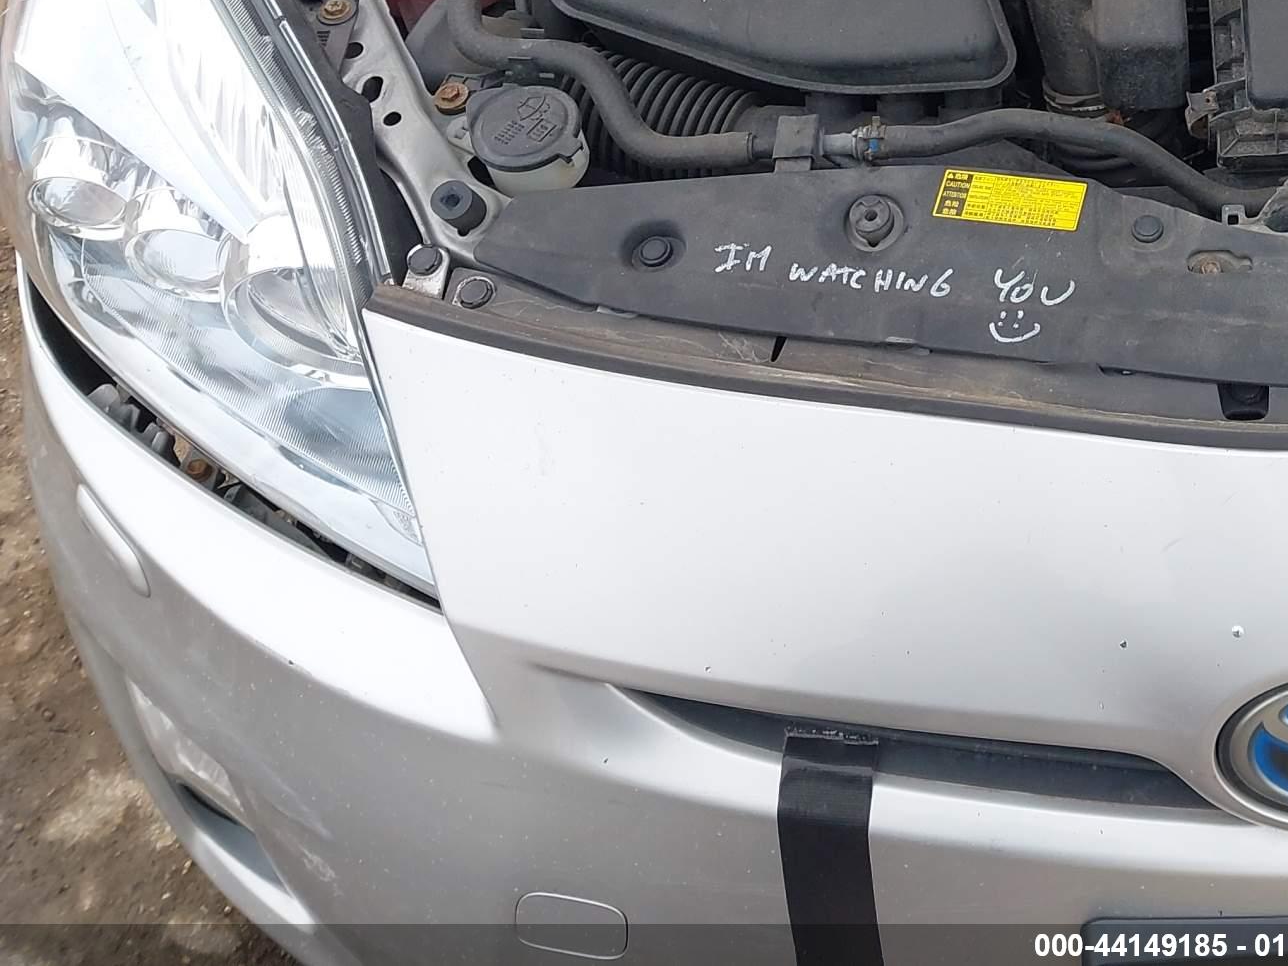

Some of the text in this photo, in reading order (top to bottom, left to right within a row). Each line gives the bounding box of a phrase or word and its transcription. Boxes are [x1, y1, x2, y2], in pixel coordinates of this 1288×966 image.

[946, 180, 970, 189] CAUTION
[789, 263, 953, 297] WATCHING
[994, 269, 1076, 306] YOU
